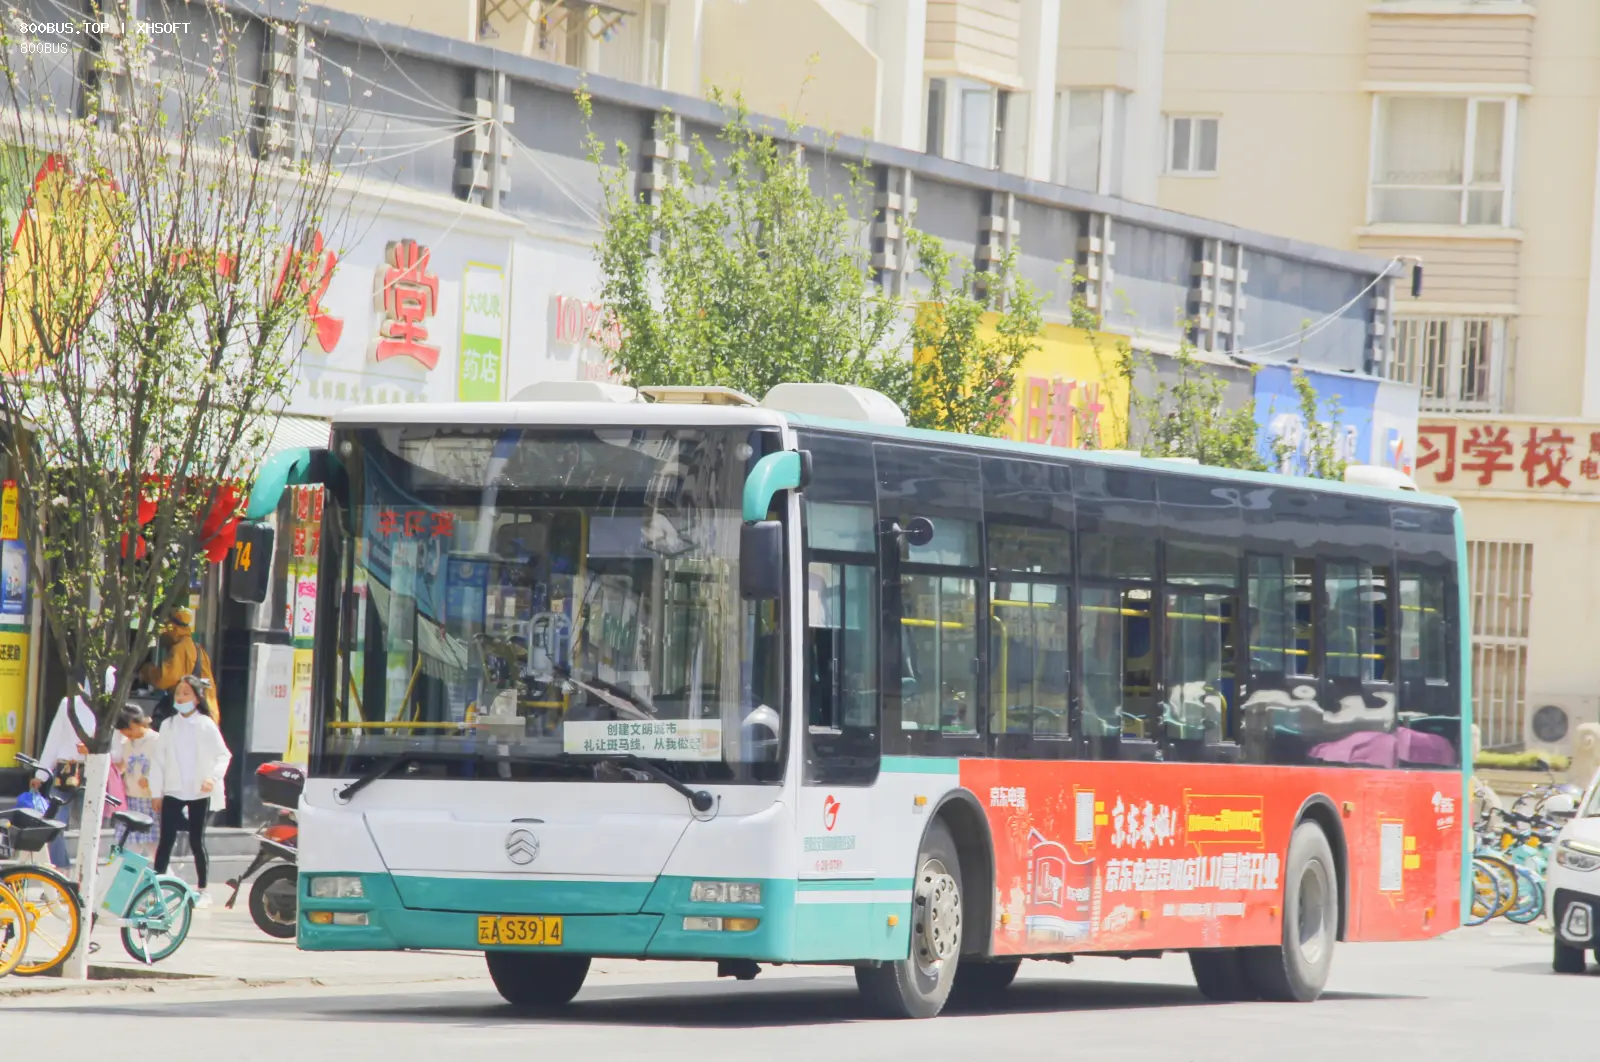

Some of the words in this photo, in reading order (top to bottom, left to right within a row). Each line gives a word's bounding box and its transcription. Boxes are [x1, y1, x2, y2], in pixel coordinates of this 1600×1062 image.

[462, 348, 499, 384] 药店
[234, 541, 252, 572] 74
[606, 722, 677, 736] 创建文明城市
